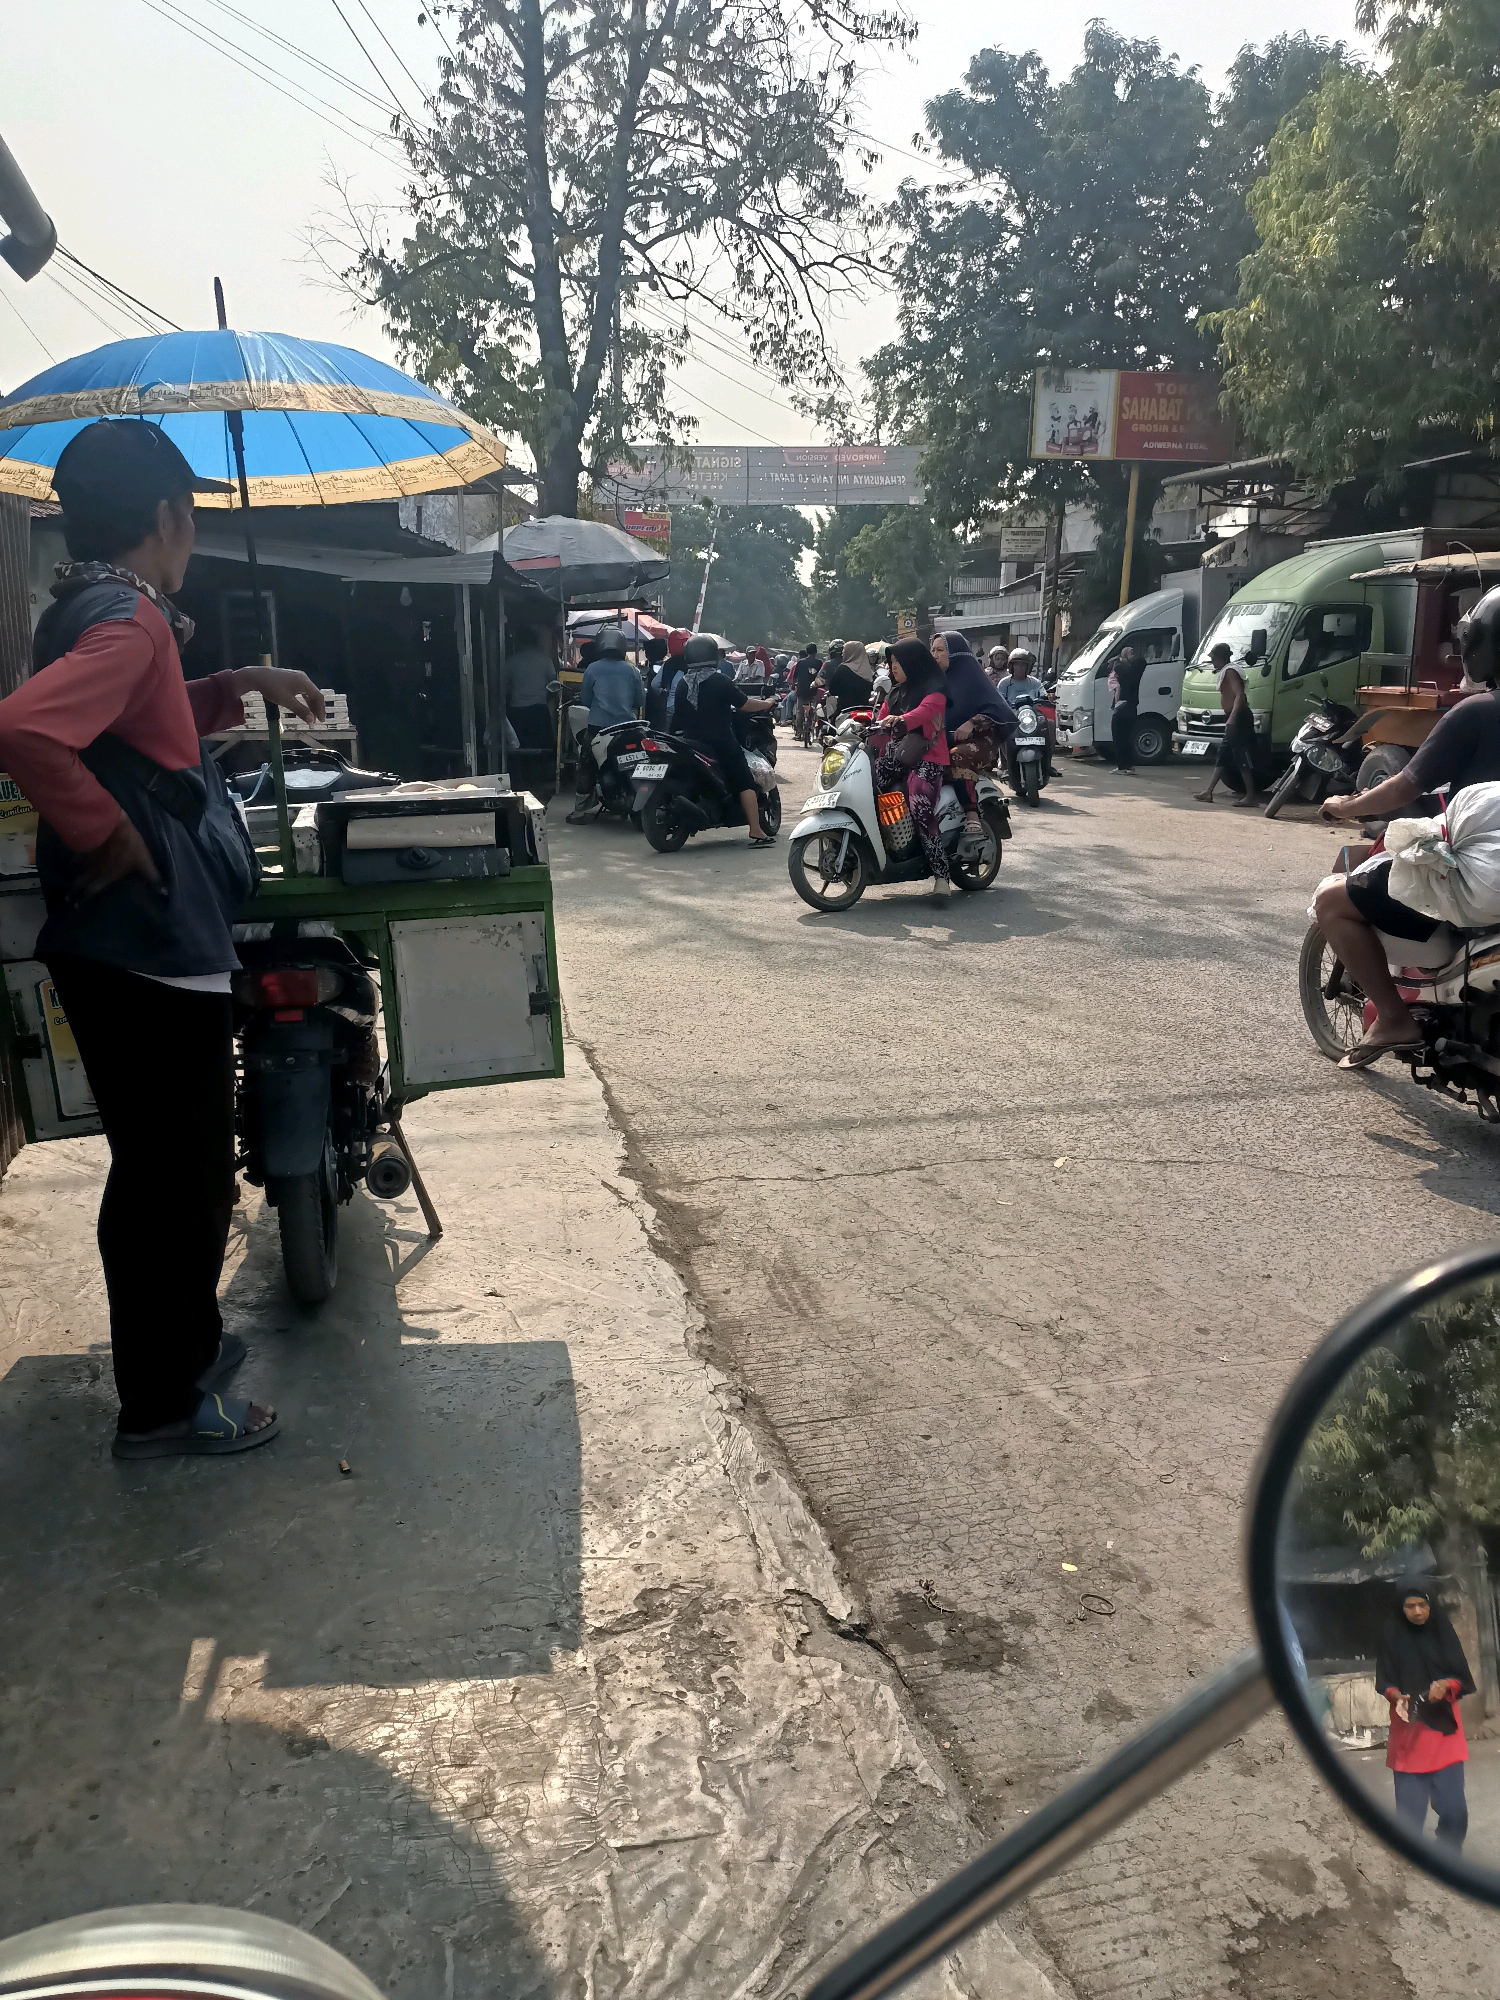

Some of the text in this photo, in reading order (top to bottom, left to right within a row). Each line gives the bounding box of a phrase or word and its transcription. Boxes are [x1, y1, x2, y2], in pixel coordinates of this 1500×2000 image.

[1155, 382, 1198, 395] TOK
[1121, 397, 1184, 421] SAHABAT
[1131, 423, 1169, 433] GROSIR
[1143, 441, 1183, 450] ADIWERNA
